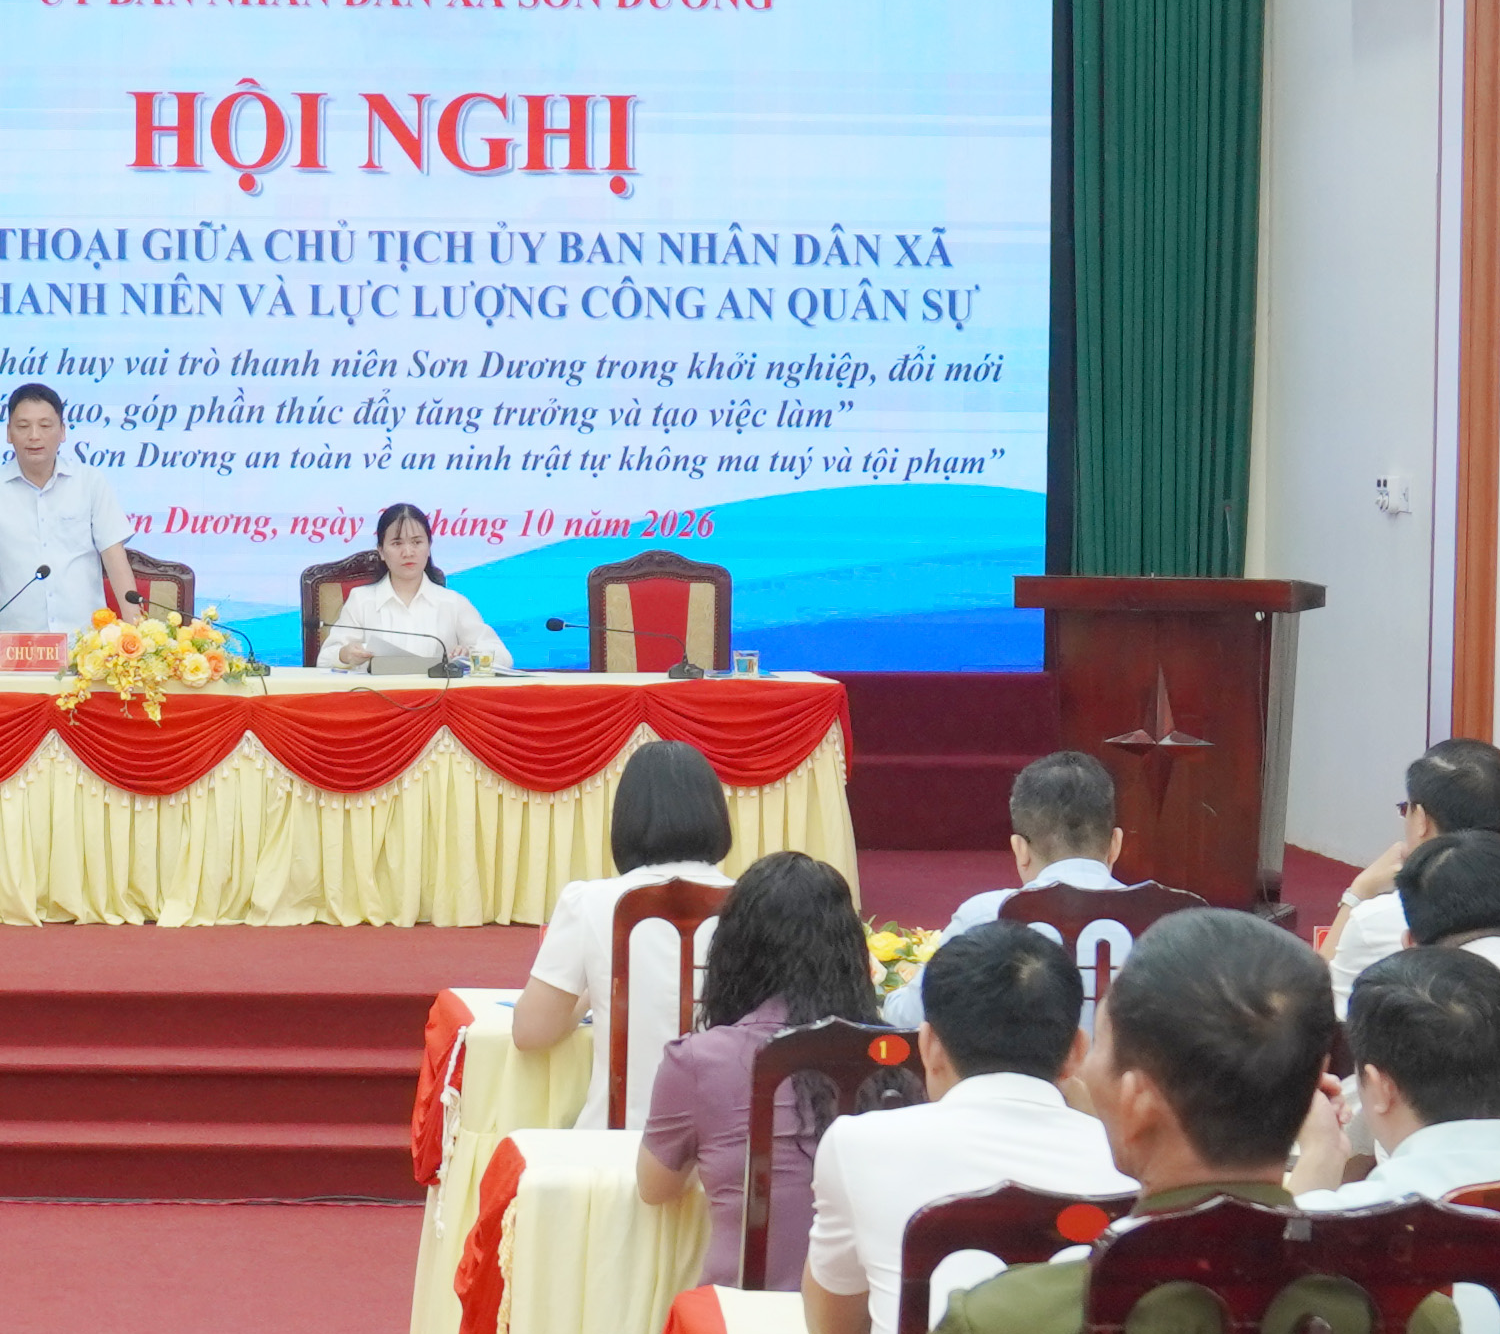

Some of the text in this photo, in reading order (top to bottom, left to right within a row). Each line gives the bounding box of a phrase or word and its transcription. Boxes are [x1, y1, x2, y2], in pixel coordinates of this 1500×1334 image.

[126, 77, 637, 195] HỘI NGHỊ
[143, 221, 253, 263] GIỮA
[265, 221, 354, 263] CHỦ
[369, 231, 473, 272] TỊCH
[491, 222, 545, 264] ỦY
[559, 232, 643, 264] BAN
[659, 222, 778, 266] NHÂN
[793, 223, 880, 267] DÂN
[894, 227, 953, 269] XÃ
[120, 274, 222, 316] NIÊN
[238, 275, 295, 316] VÀ
[311, 280, 398, 326] LỰC
[414, 281, 566, 328] LƯỢNG
[582, 277, 705, 320] CÔNG
[716, 288, 773, 321] AN
[788, 278, 909, 328] QUÂN
[922, 284, 980, 332] SỰ
[56, 347, 114, 383] huy
[125, 348, 169, 376] vai
[179, 348, 219, 376] trò
[231, 349, 319, 377] thanh
[331, 349, 397, 377] niên
[407, 350, 467, 378] Sơn
[479, 351, 587, 386] Dương
[596, 355, 678, 386] trong
[687, 352, 757, 381] khởi
[765, 352, 876, 387] nghiệp,
[889, 345, 936, 383] đổi
[944, 350, 1003, 383] mới
[120, 395, 177, 431] góp
[184, 388, 264, 431] phần
[276, 396, 343, 424] thúc
[354, 389, 406, 432] đẩy
[416, 398, 483, 433] tăng
[493, 398, 598, 434] trưởng
[610, 398, 641, 427] và
[652, 403, 697, 434] tạo
[710, 399, 767, 435] việc
[777, 399, 853, 429] làm”
[136, 443, 236, 476] Dương
[246, 452, 279, 468] an
[290, 443, 351, 469] toàn
[364, 437, 392, 469] về
[401, 453, 435, 470] an
[446, 445, 510, 470] ninh
[522, 445, 571, 477] trật
[580, 450, 611, 478] tự
[619, 446, 707, 479] không
[717, 455, 759, 472] ma
[769, 447, 813, 480] tuý
[823, 447, 852, 473] và
[862, 448, 898, 479] tội
[905, 448, 1006, 482] phạm”
[165, 507, 277, 542] Dương,
[291, 507, 364, 543] ngày
[520, 509, 554, 536] 10
[564, 511, 630, 537] năm
[642, 510, 713, 537] 2026
[6, 641, 59, 661] CHỦ TRÌ
[879, 1040, 887, 1059] 1
